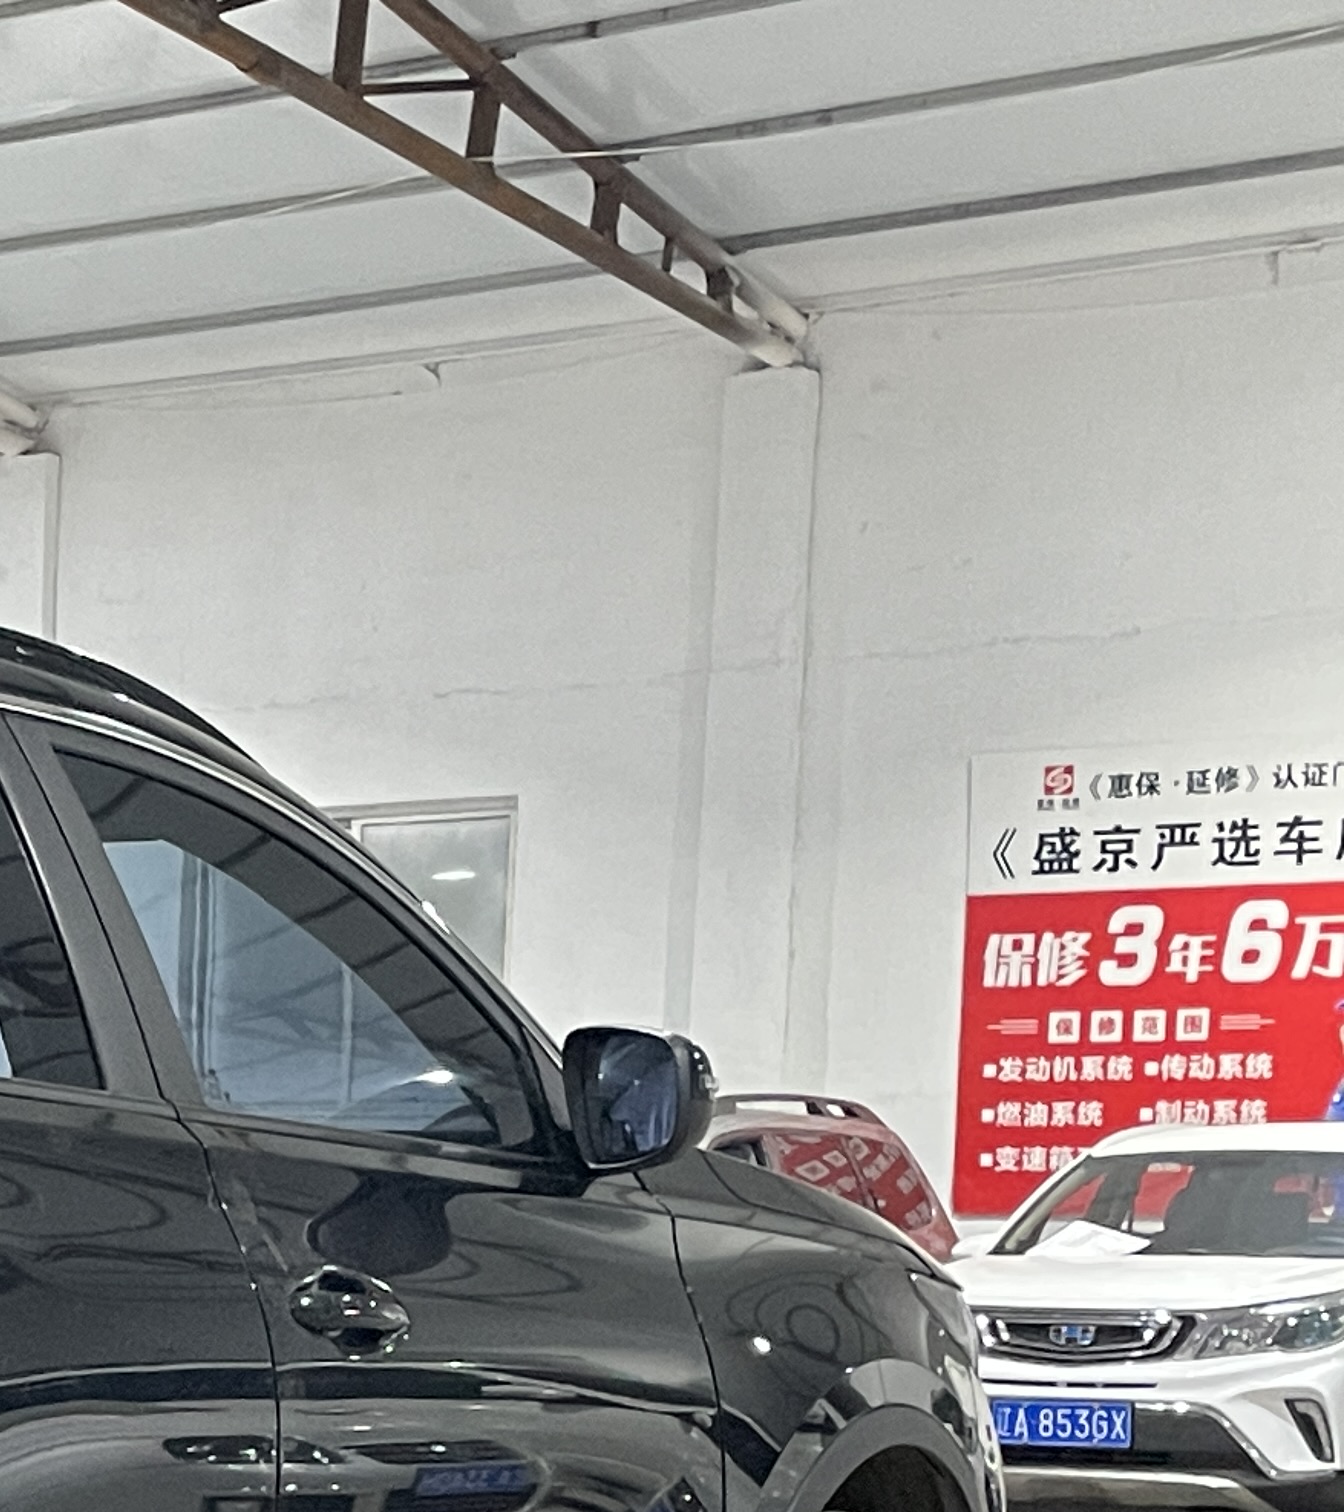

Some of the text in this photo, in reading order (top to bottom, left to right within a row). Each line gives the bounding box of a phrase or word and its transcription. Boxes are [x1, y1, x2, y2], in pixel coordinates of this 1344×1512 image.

[992, 814, 1344, 879] 《盛京严选车
[983, 899, 1344, 987] 保修3年6万
[998, 1055, 1134, 1082] 发动机系统
[1160, 1053, 1274, 1080] 传动系统
[995, 1101, 1104, 1127] 燃油系统
[1155, 1099, 1268, 1125] 制动系统
[994, 1145, 1092, 1172] 变速箱
